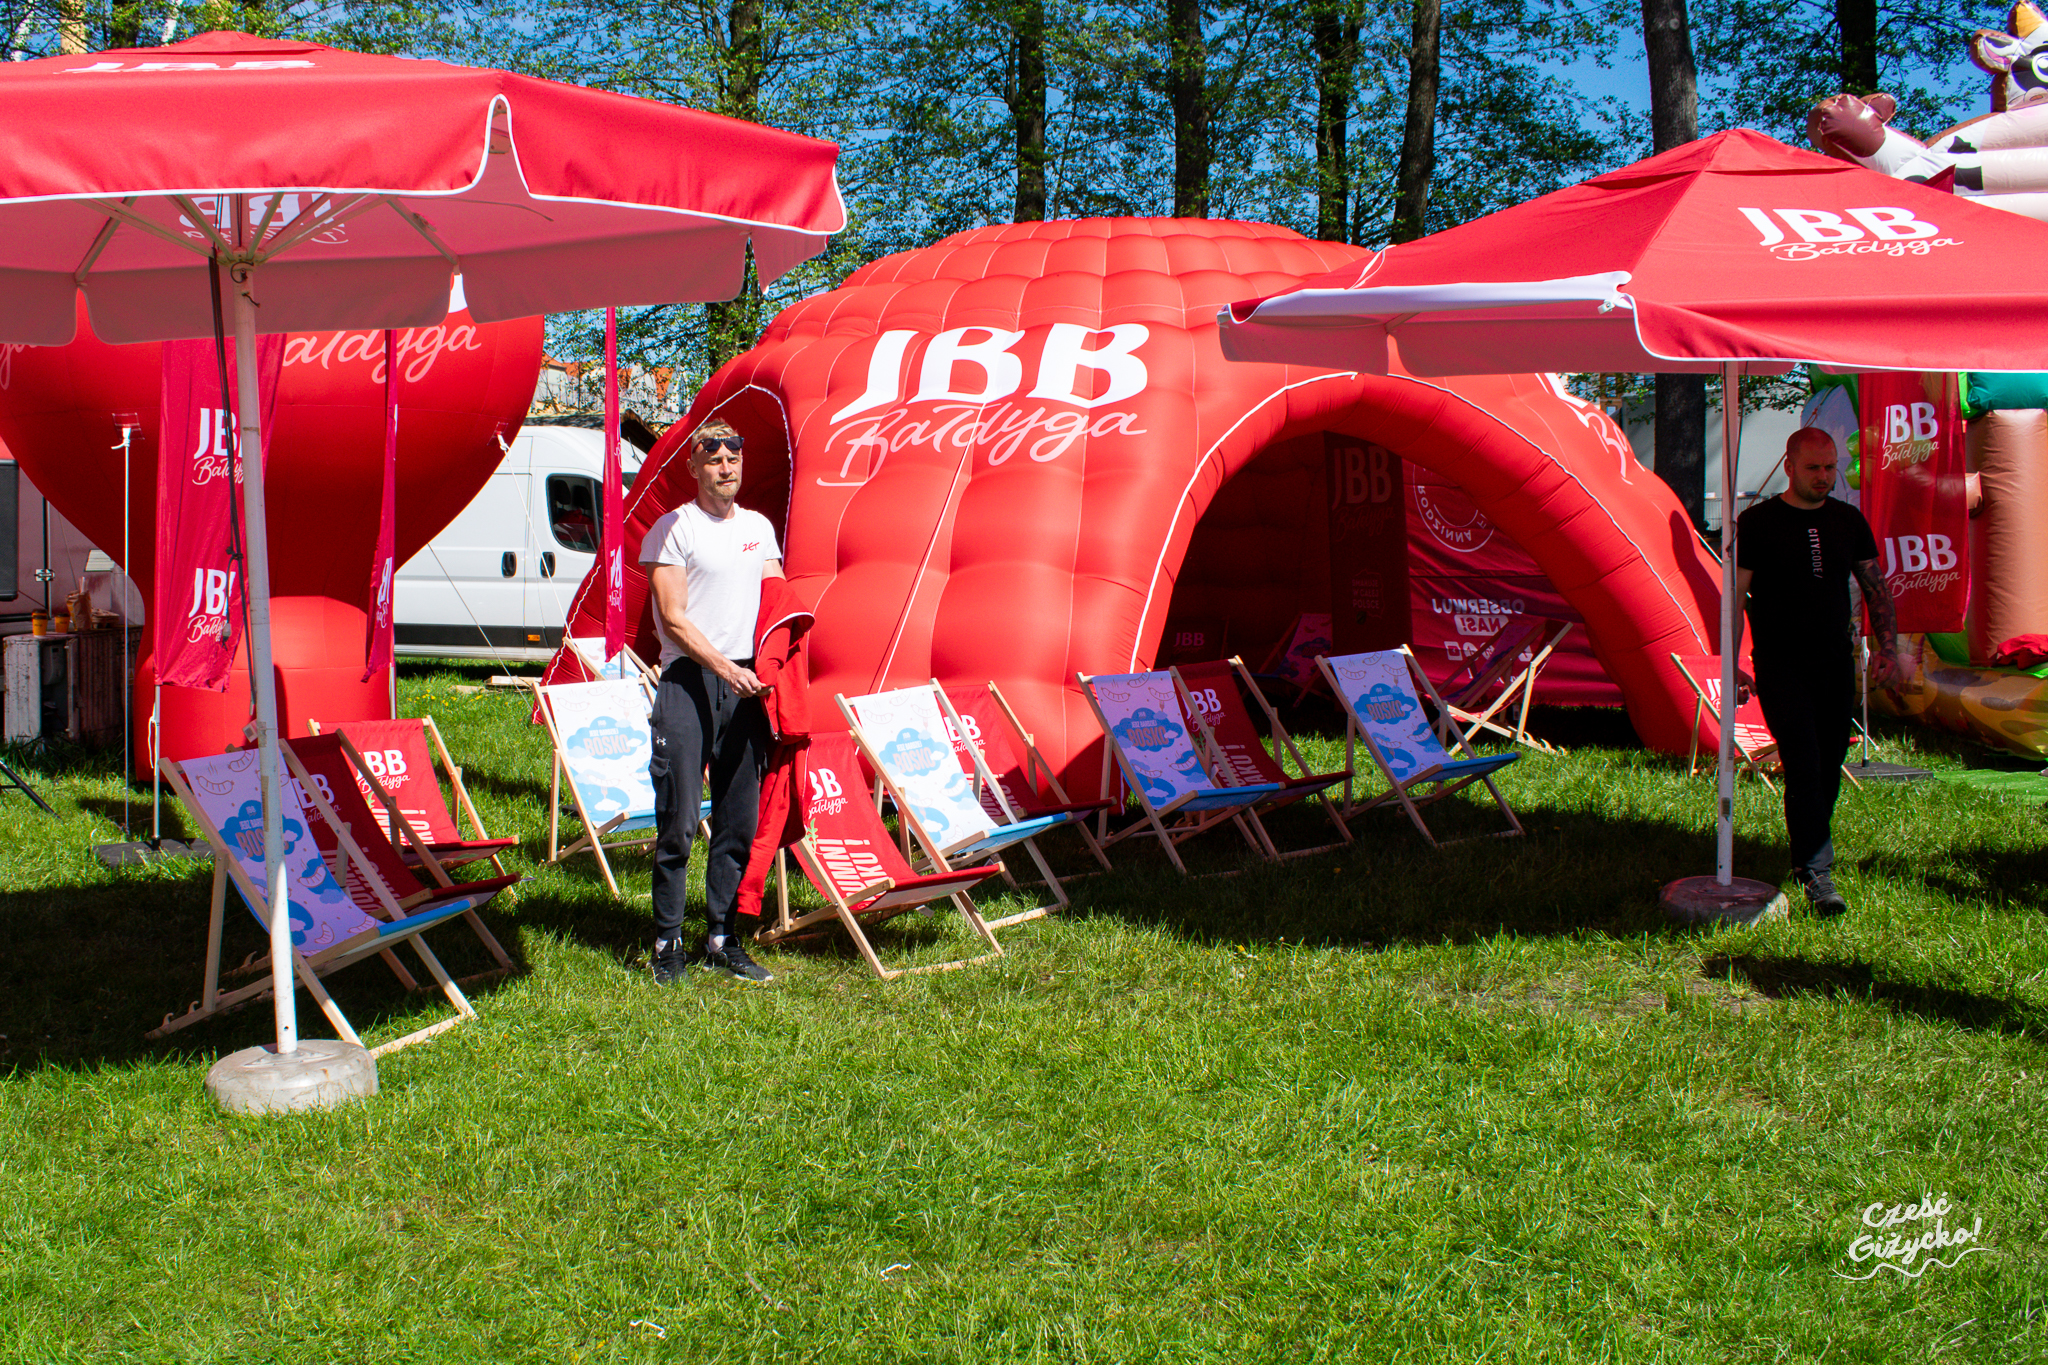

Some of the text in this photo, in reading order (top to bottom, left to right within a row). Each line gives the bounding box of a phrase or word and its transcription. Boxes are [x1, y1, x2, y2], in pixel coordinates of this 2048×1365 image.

[1737, 206, 1941, 247] JBB
[1769, 238, 1965, 262] Bałdyga
[282, 324, 482, 385] adyga
[829, 322, 1151, 426] JBB
[193, 407, 243, 460] JB
[816, 401, 1148, 487] Bałdyga
[1331, 446, 1392, 512] JBB
[1884, 533, 1958, 579] JBB
[808, 797, 849, 820] ałdyga
[809, 767, 843, 801] BB
[816, 838, 867, 898] UMNI
